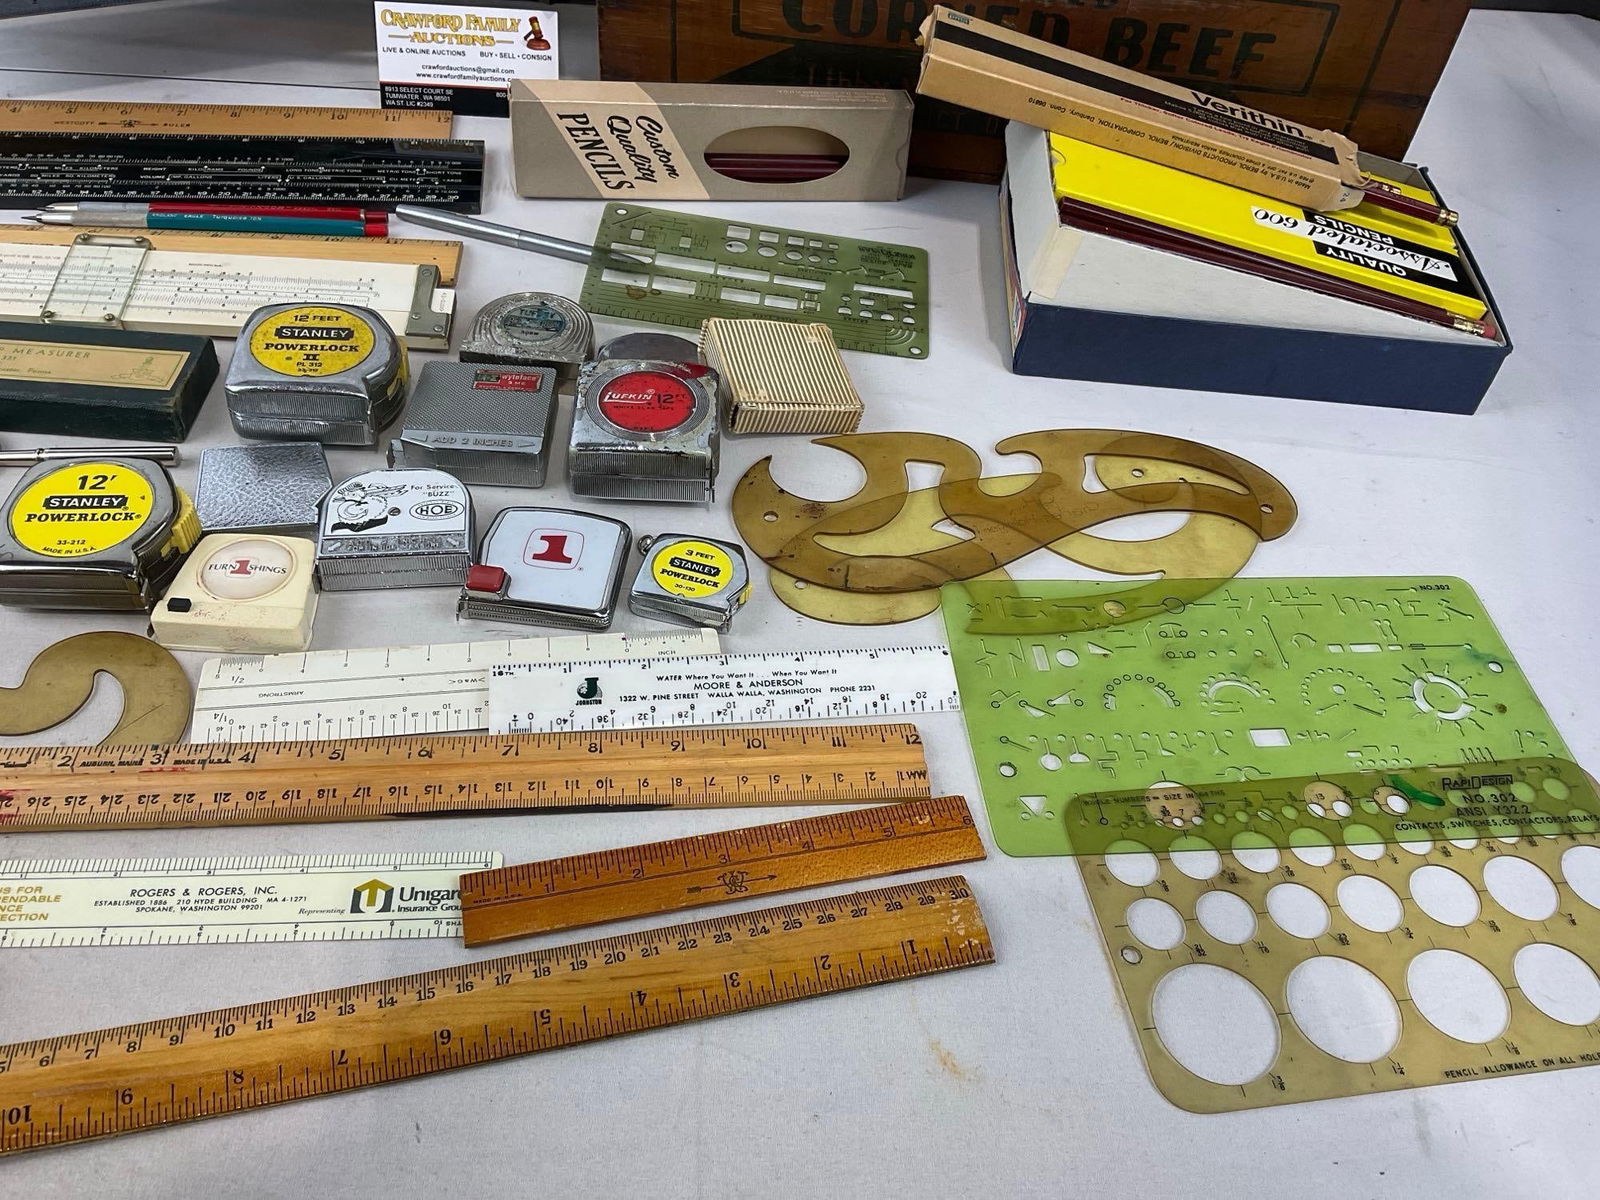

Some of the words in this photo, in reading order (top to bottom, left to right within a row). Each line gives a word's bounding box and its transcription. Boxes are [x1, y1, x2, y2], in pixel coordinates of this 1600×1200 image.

[409, 32, 496, 47] AUCTIONS
[405, 48, 430, 56] ONLINE
[431, 49, 466, 57] AUCTIONS
[1101, 17, 1276, 80] BEEF
[521, 53, 552, 61] CONSIGN
[422, 63, 515, 75] crawfordauctions@gmail.com
[416, 72, 520, 83] www.crawfordfamilyauctions.c
[423, 87, 444, 95] COURT
[1190, 91, 1305, 137] Verithin
[556, 112, 635, 192] PENCILS
[605, 115, 658, 183] Quality
[635, 115, 680, 180] Custom
[1254, 208, 1299, 229] 600
[1313, 215, 1393, 246] PENCILS
[1325, 246, 1407, 277] QUALITY
[293, 314, 309, 323] 12
[281, 327, 350, 338] STANLEY
[263, 342, 360, 353] POWERLOCK
[656, 393, 674, 404] 12
[77, 474, 119, 490] 12'
[49, 497, 123, 508] STANLEY
[419, 504, 454, 515] HOE
[41, 546, 62, 555] MADE
[695, 551, 715, 561] FEET
[673, 558, 718, 575] STANLEY
[659, 568, 720, 588] POWERLOCK
[693, 681, 730, 690] MOORE
[736, 681, 743, 689] &
[749, 678, 803, 688] ANDERSON
[257, 690, 305, 698] ARMSTRONG
[768, 687, 822, 696] WASHINGTON
[859, 684, 876, 692] 2231
[1163, 793, 1183, 801] SIZE
[1456, 806, 1488, 817] ANSI
[16, 886, 43, 894] FOR
[130, 888, 176, 898] ROGERS
[182, 888, 191, 897] &
[198, 887, 246, 896] ROGERS,
[254, 886, 278, 895] INC.
[94, 899, 146, 907] ESTABLISHED
[180, 904, 238, 912] WASHINGTON
[397, 904, 438, 913] Insurance
[440, 903, 463, 912] Grou
[298, 907, 346, 916] Representing
[1444, 1068, 1479, 1079] PENCIL
[1483, 1060, 1538, 1074] ALLOWANCE
[1542, 1058, 1555, 1066] ON
[1559, 1056, 1576, 1065] ALL
